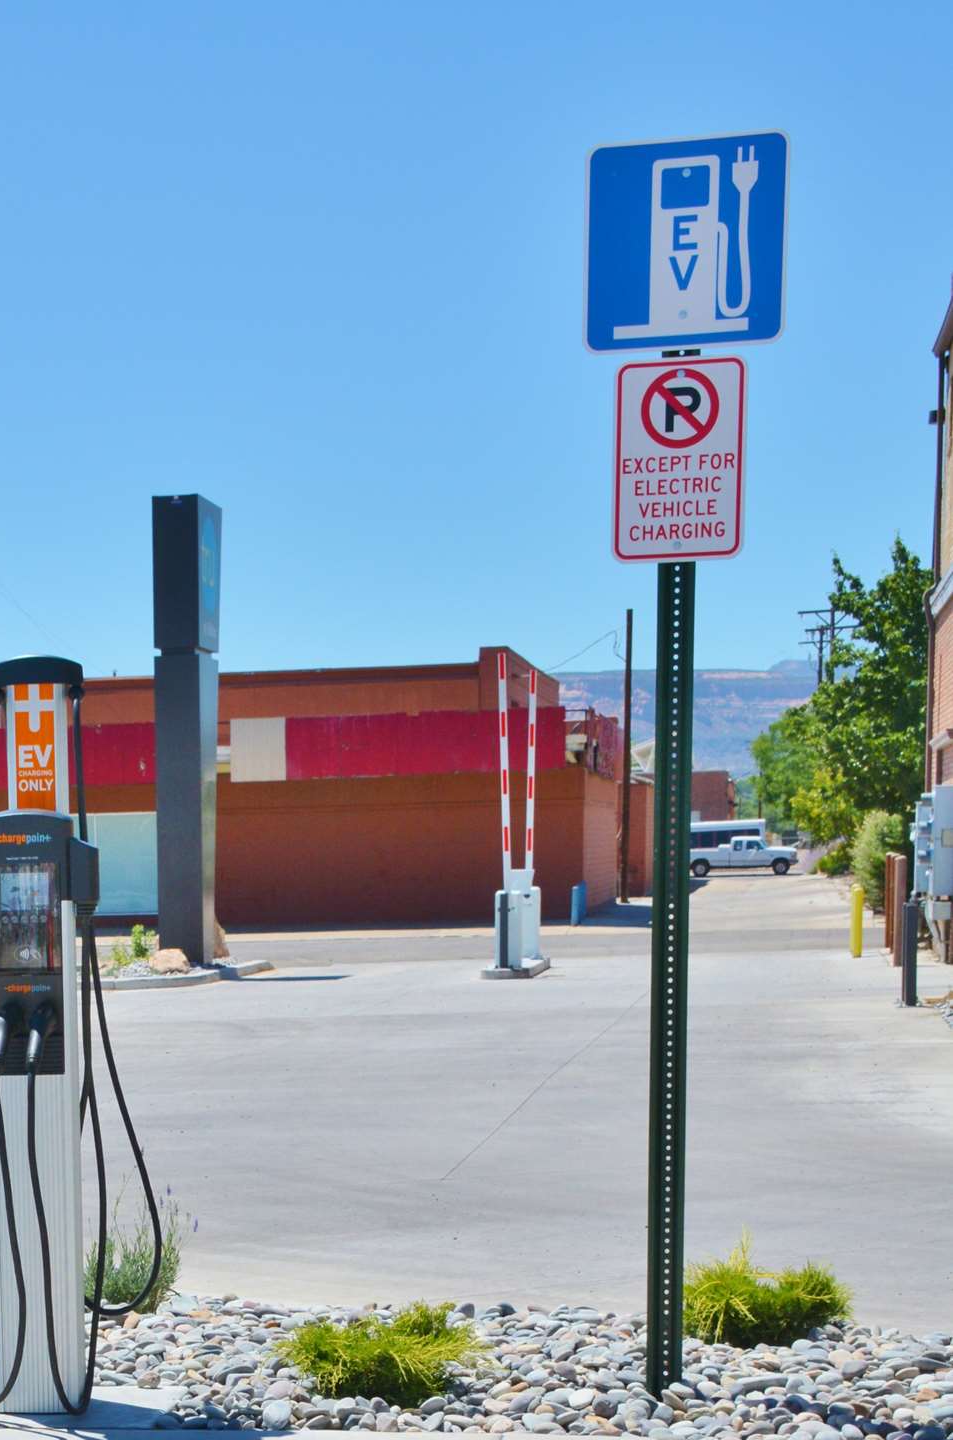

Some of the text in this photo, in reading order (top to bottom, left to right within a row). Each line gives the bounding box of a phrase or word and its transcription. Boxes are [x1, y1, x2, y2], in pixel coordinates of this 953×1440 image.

[668, 214, 699, 291] EV
[622, 452, 734, 474] EXCEPT FOR
[634, 475, 722, 496] ELECTRIC
[638, 499, 717, 518] VEHICLE
[629, 521, 725, 541] CHARGING
[19, 744, 53, 768] EV
[19, 769, 53, 777] CHARGING
[19, 778, 54, 792] ONLY
